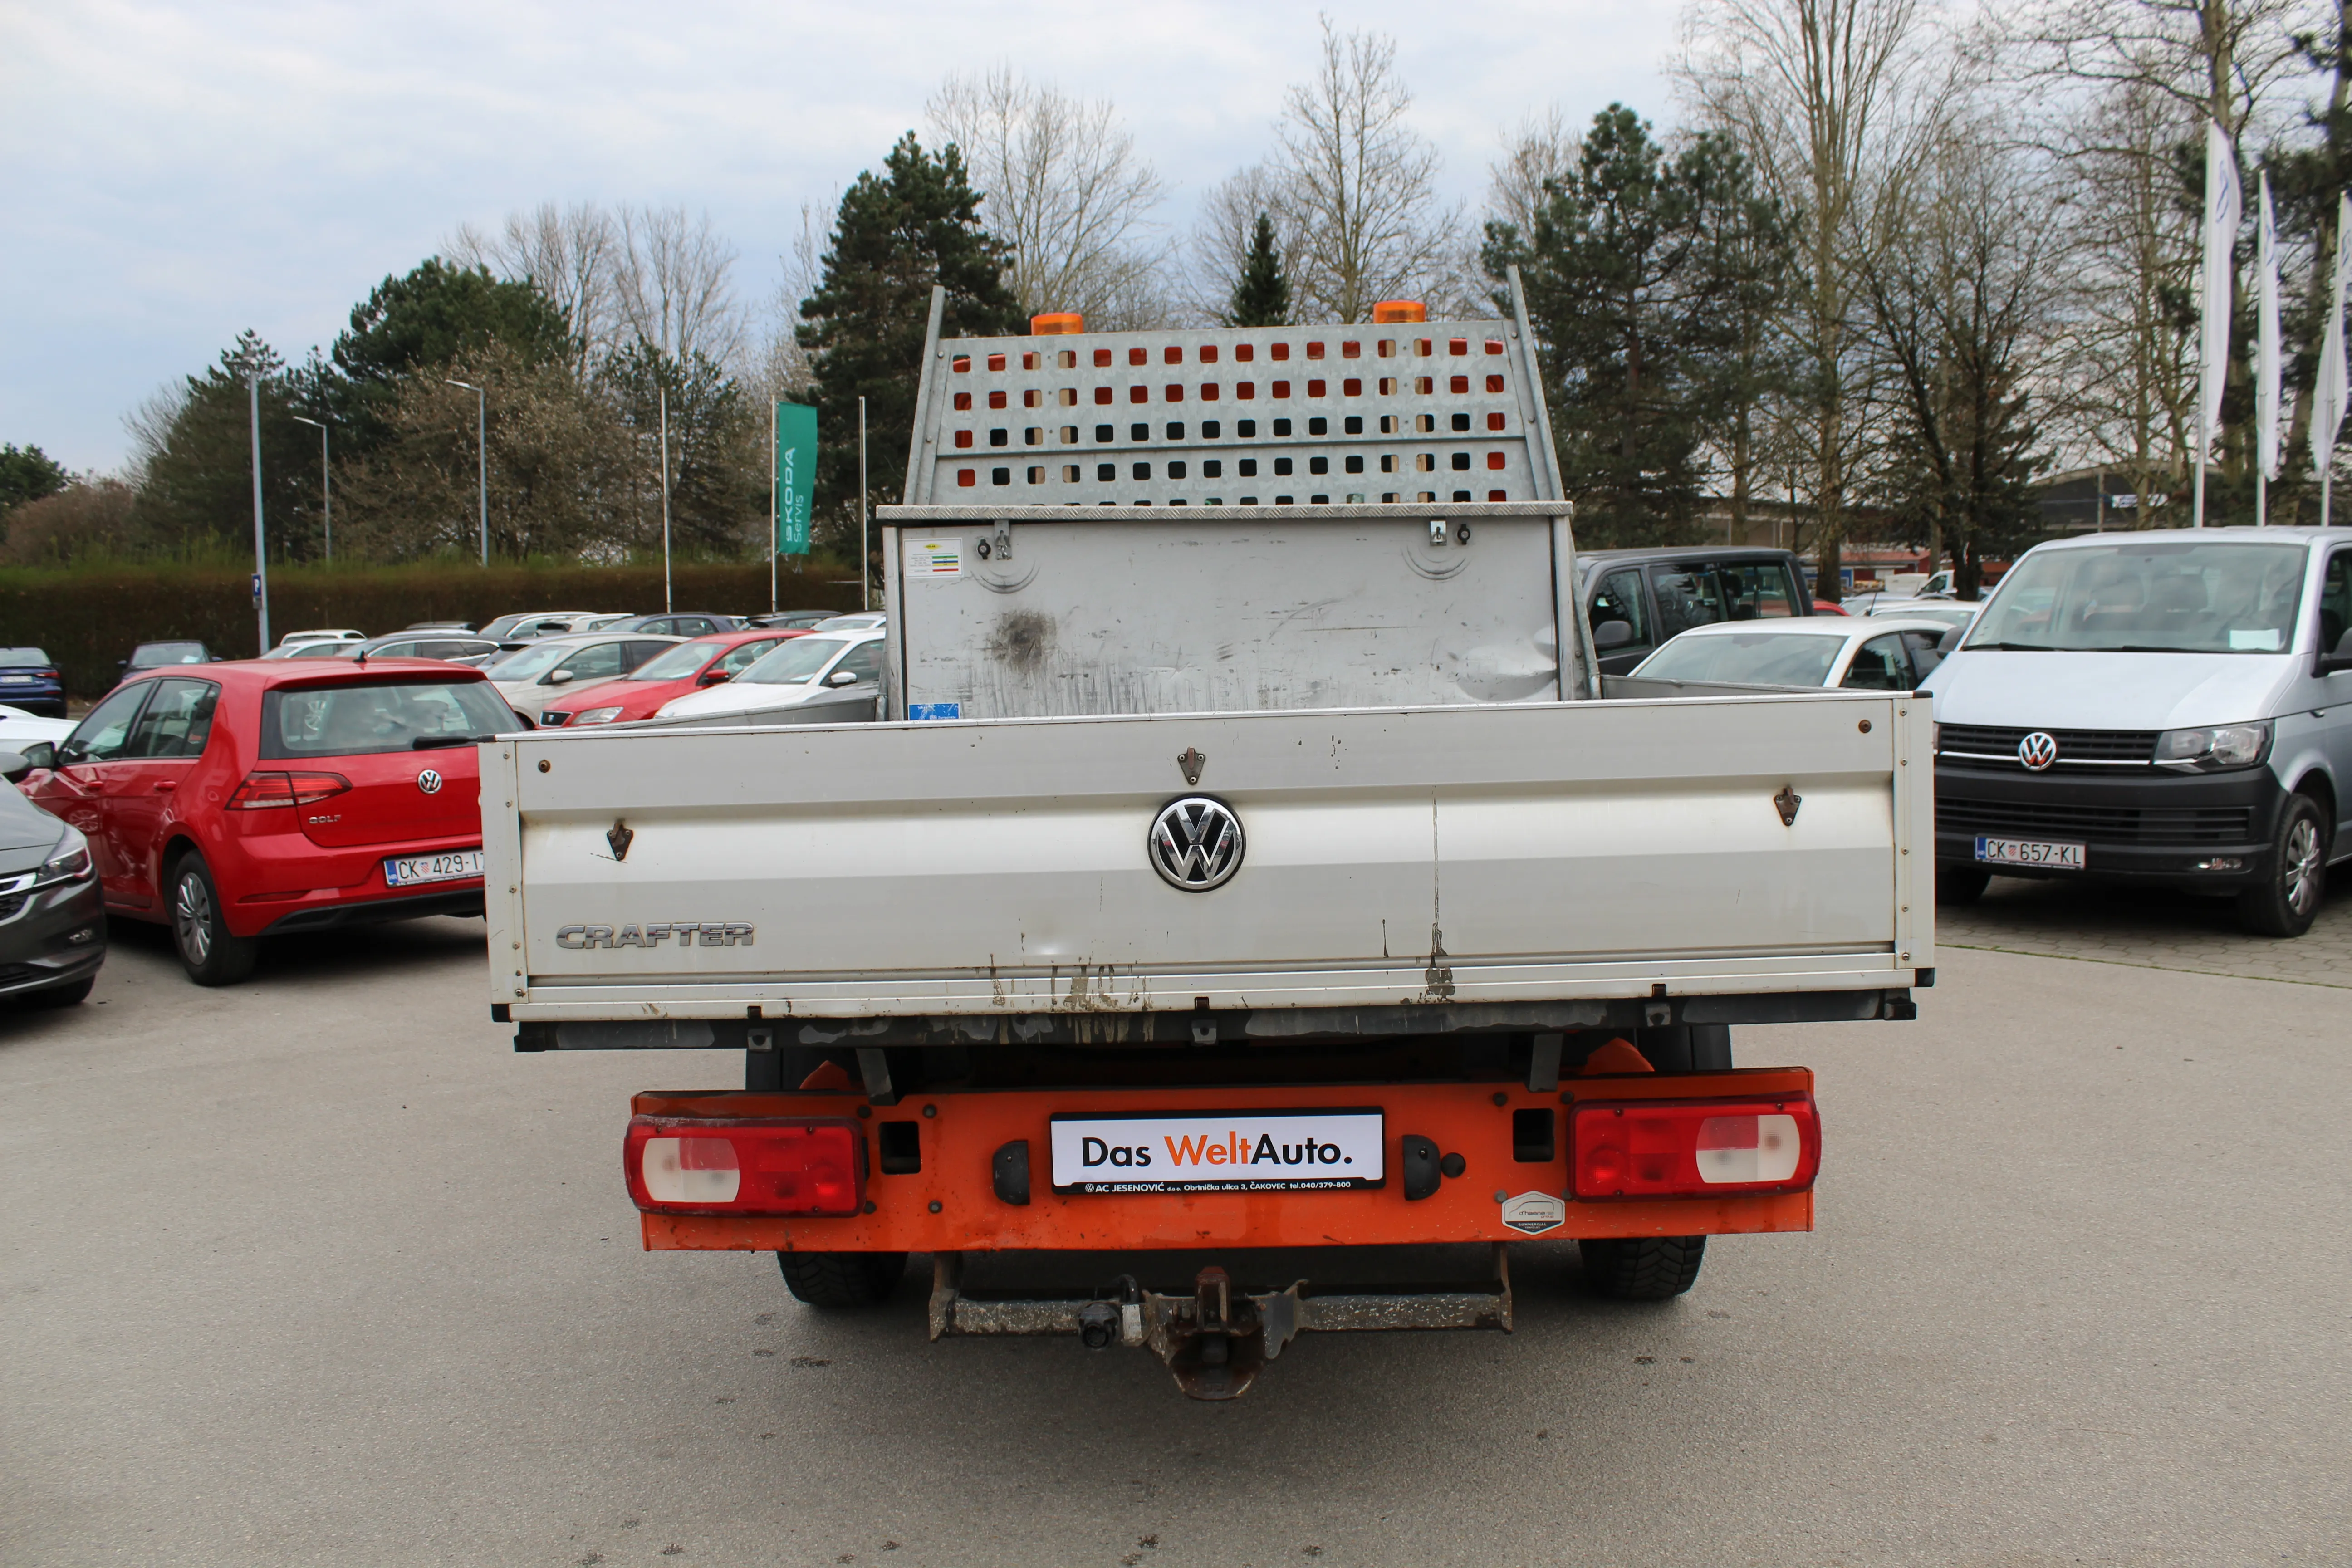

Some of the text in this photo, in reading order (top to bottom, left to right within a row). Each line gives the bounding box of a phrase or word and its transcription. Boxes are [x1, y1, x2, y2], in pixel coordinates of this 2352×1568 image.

[794, 495, 804, 542] Servis
[309, 815, 341, 824] GOLF
[1988, 840, 2006, 858] CK
[2020, 843, 2081, 864] 657-KL
[399, 860, 420, 879] CK
[433, 853, 484, 875] 429-I
[556, 921, 755, 949] CRAFTER
[1081, 1131, 1352, 1167] Das WeltAuto.
[1112, 1182, 1165, 1192] JESENOVIĆ
[1250, 1181, 1286, 1190] ČAKOVEC
